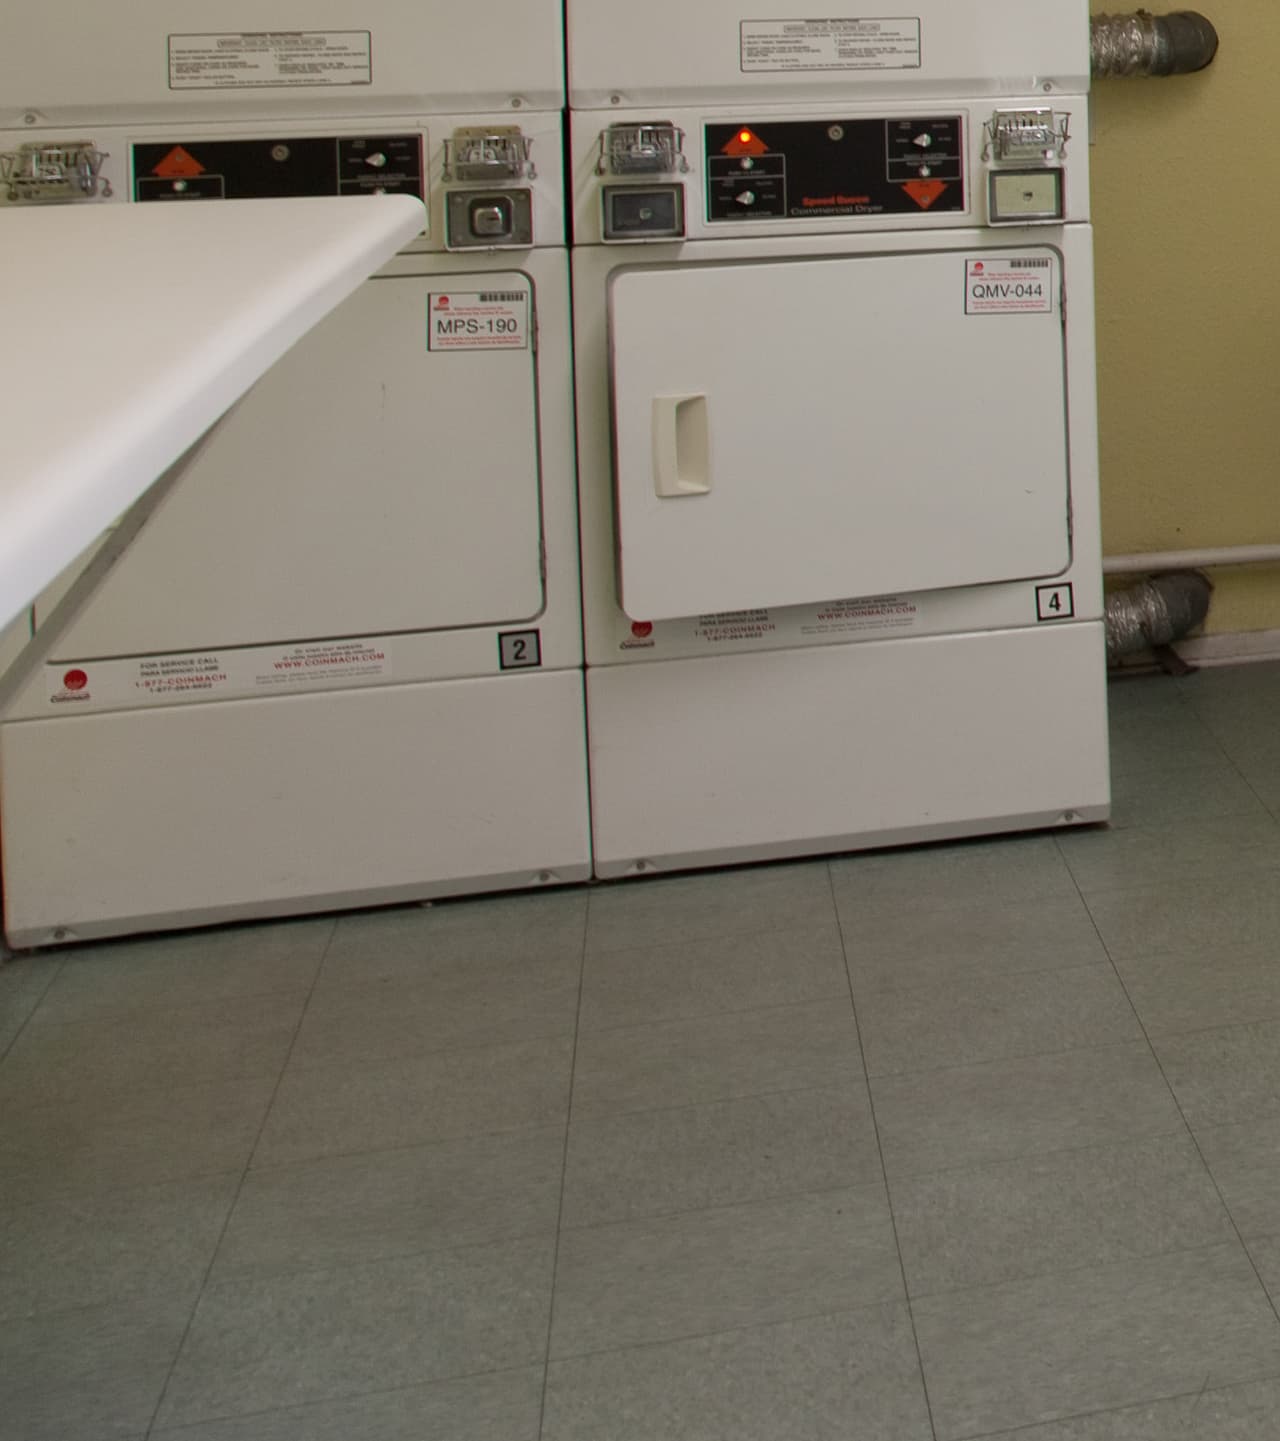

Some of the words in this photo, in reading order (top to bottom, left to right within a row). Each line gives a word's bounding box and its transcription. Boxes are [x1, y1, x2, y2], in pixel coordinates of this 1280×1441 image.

[972, 284, 1043, 300] QMV-044
[437, 318, 518, 335] MPS-190
[1049, 592, 1062, 612] 4
[513, 639, 528, 661] 2
[135, 673, 227, 688] 1-877-COINMACH
